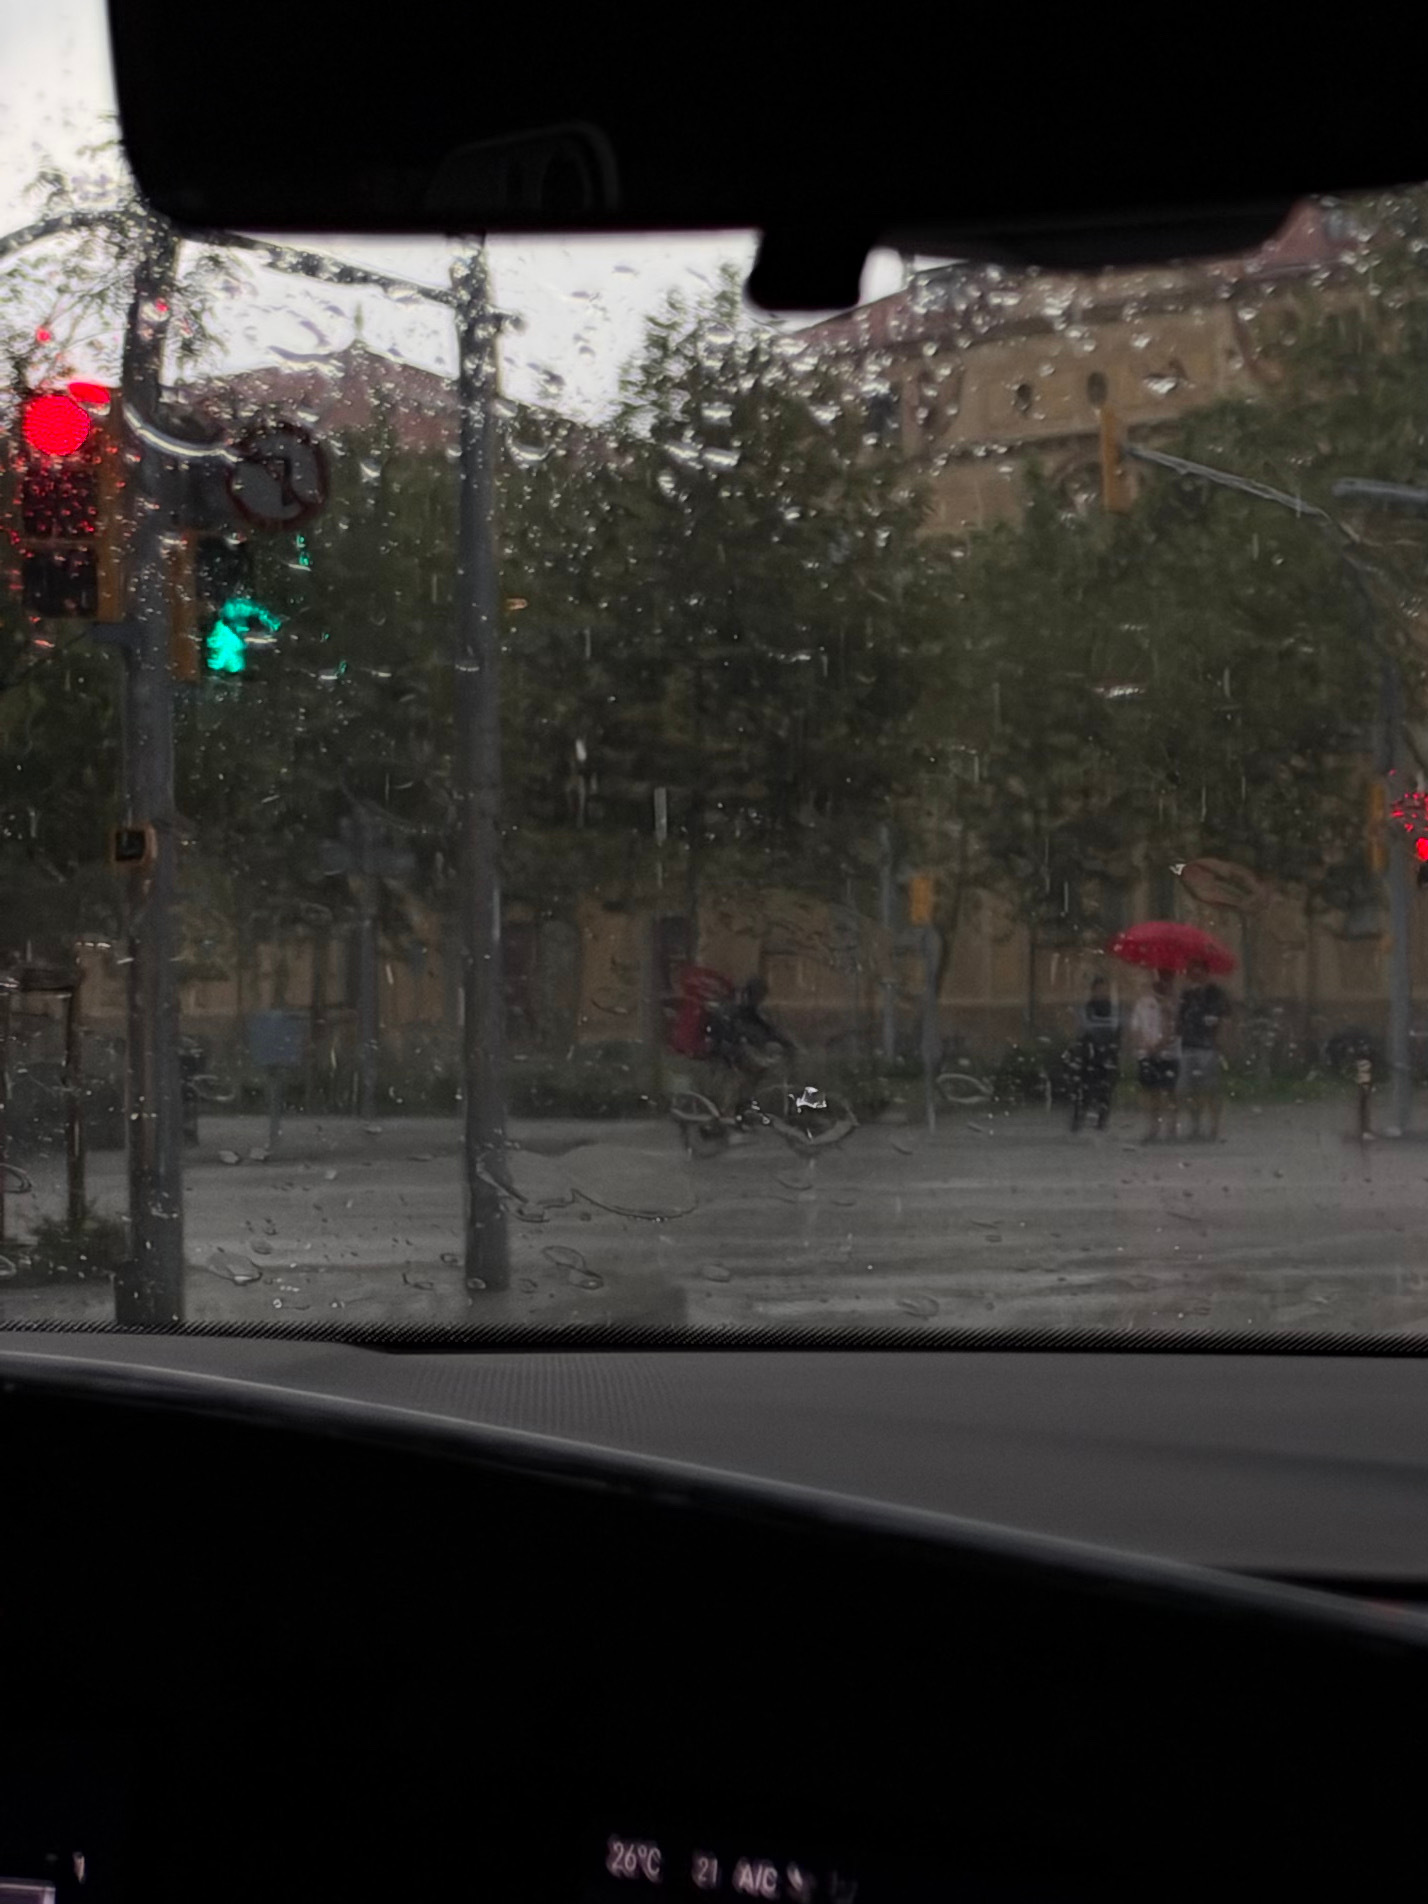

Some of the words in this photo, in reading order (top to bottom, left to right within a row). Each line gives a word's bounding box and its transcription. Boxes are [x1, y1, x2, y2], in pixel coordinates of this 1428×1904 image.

[609, 1837, 662, 1878] 26°C
[696, 1855, 720, 1885] 21
[737, 1861, 780, 1895] A/C
